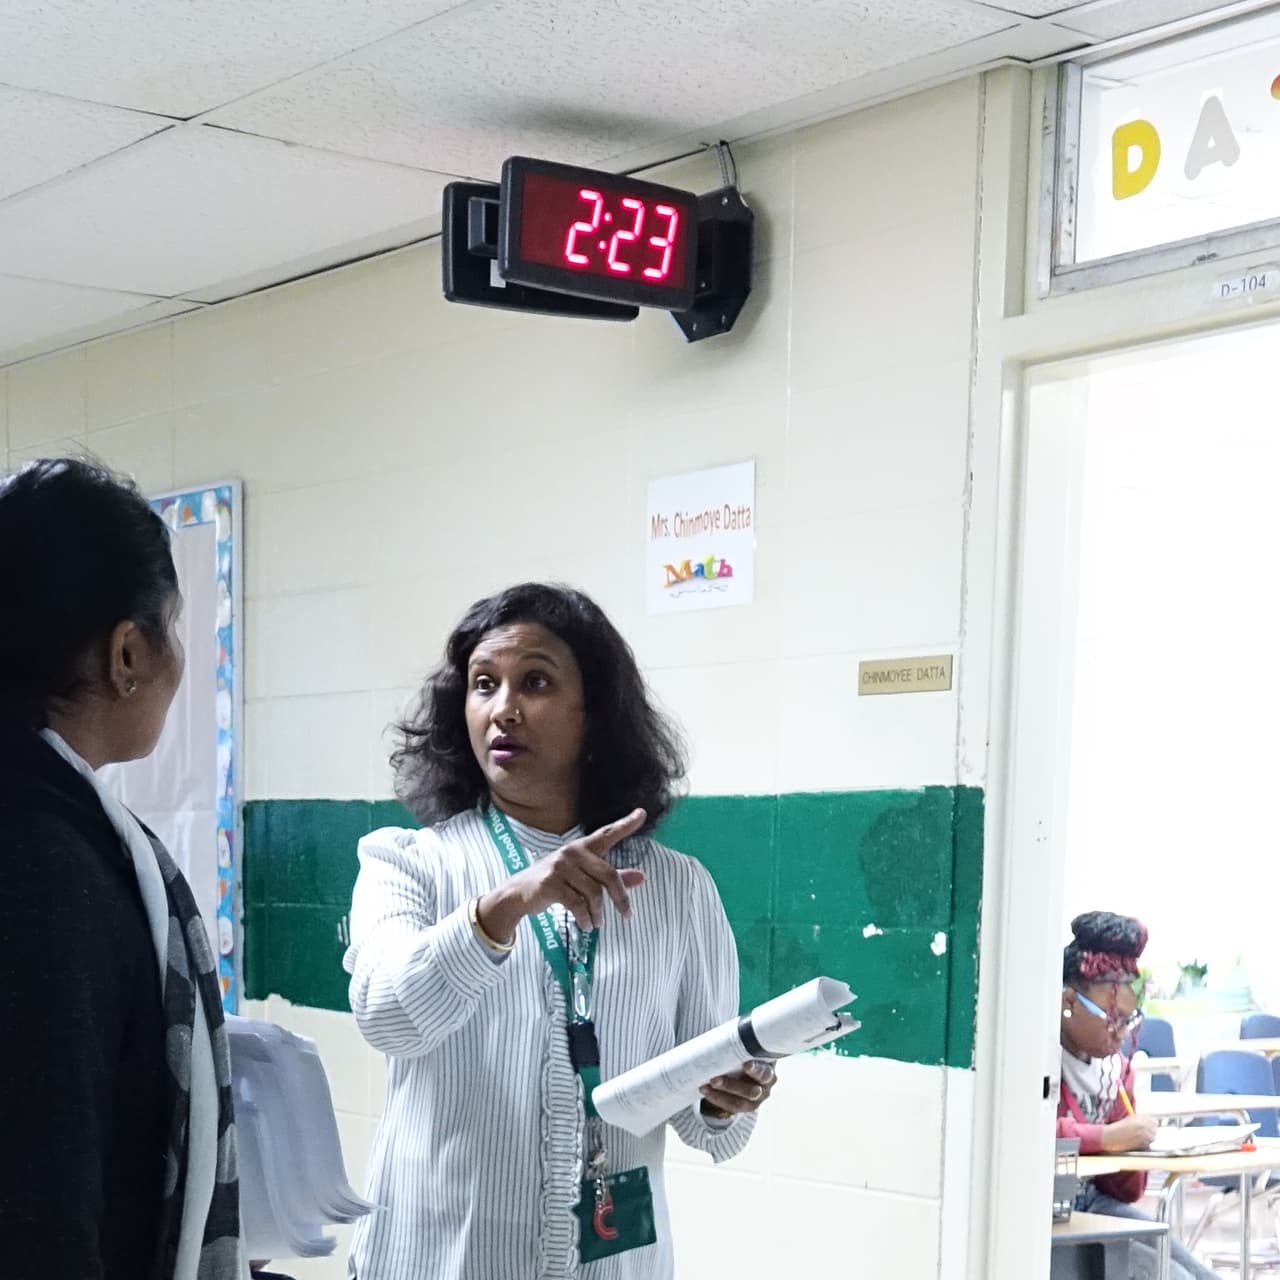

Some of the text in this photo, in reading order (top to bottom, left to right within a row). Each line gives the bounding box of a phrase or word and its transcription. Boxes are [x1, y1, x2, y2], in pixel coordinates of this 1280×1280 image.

[565, 188, 679, 279] 2:23
[1221, 273, 1266, 297] D-104
[651, 513, 671, 541] Mrs.
[723, 503, 752, 531] Datta
[916, 665, 946, 681] DATTA
[498, 832, 524, 870] School
[537, 911, 559, 950] Duran
